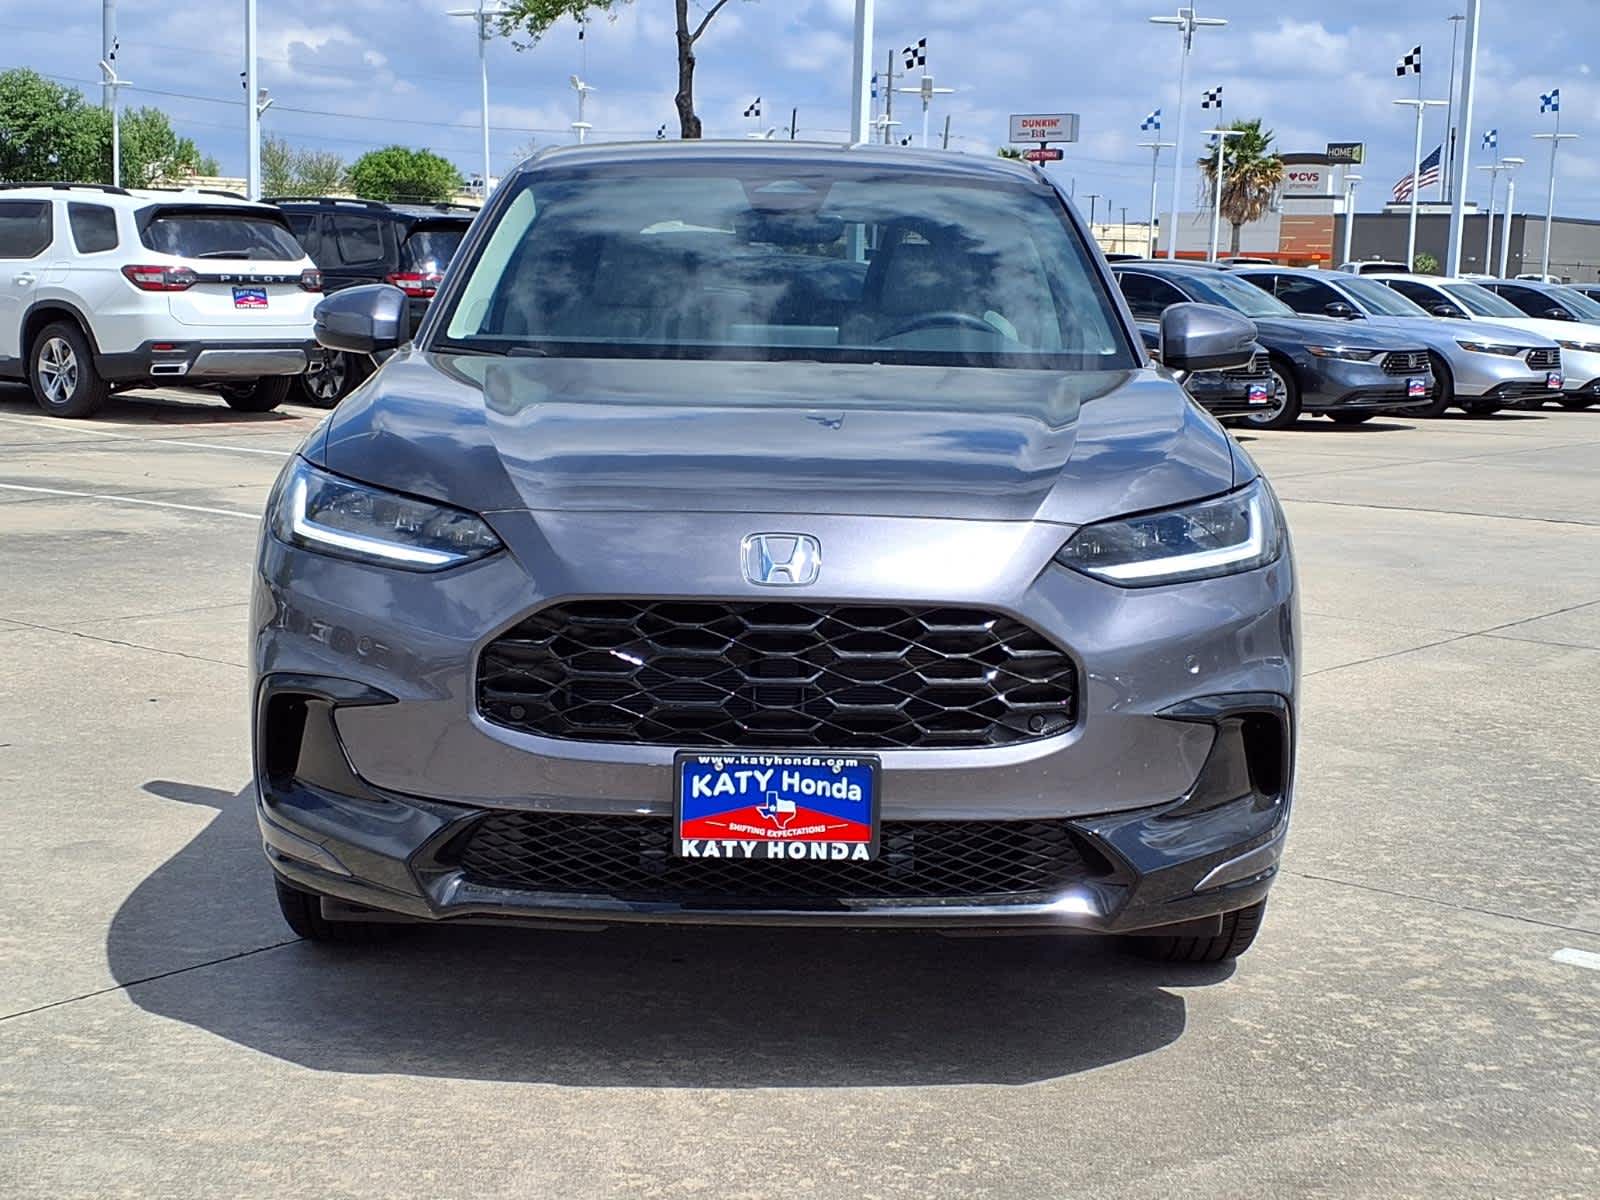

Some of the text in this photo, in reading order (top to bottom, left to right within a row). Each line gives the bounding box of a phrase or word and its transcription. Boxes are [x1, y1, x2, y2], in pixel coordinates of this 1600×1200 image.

[1022, 119, 1060, 128] DUNKIN'
[1328, 147, 1352, 157] HOME
[1298, 172, 1320, 182] CVS
[698, 755, 858, 767] www.katyhonda.com
[692, 769, 862, 802] KATY Honda
[729, 822, 826, 838] SHIFTING EXPECTATIONS
[681, 839, 870, 861] KATY HONDA
